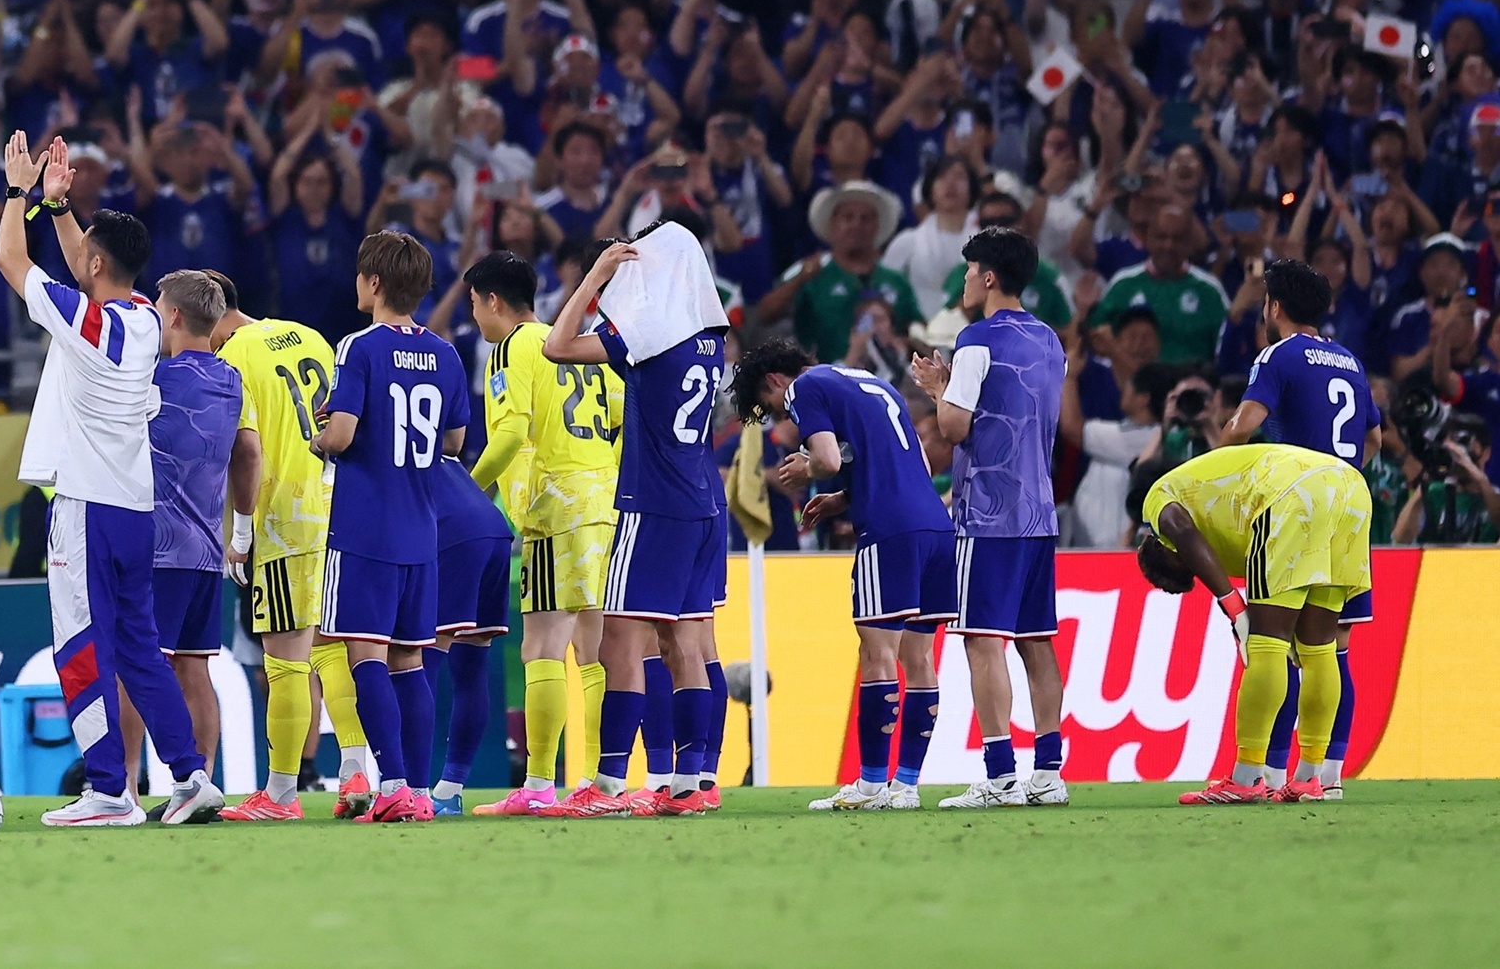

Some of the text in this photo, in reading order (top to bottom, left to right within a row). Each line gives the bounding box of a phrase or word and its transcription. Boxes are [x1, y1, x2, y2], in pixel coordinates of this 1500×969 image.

[264, 331, 302, 351] OSAKO
[393, 350, 438, 372] OGAWA
[275, 357, 330, 441] 12
[389, 382, 443, 469] 19
[557, 364, 611, 442] 23
[858, 382, 910, 451] 7
[1327, 377, 1357, 458] 2
